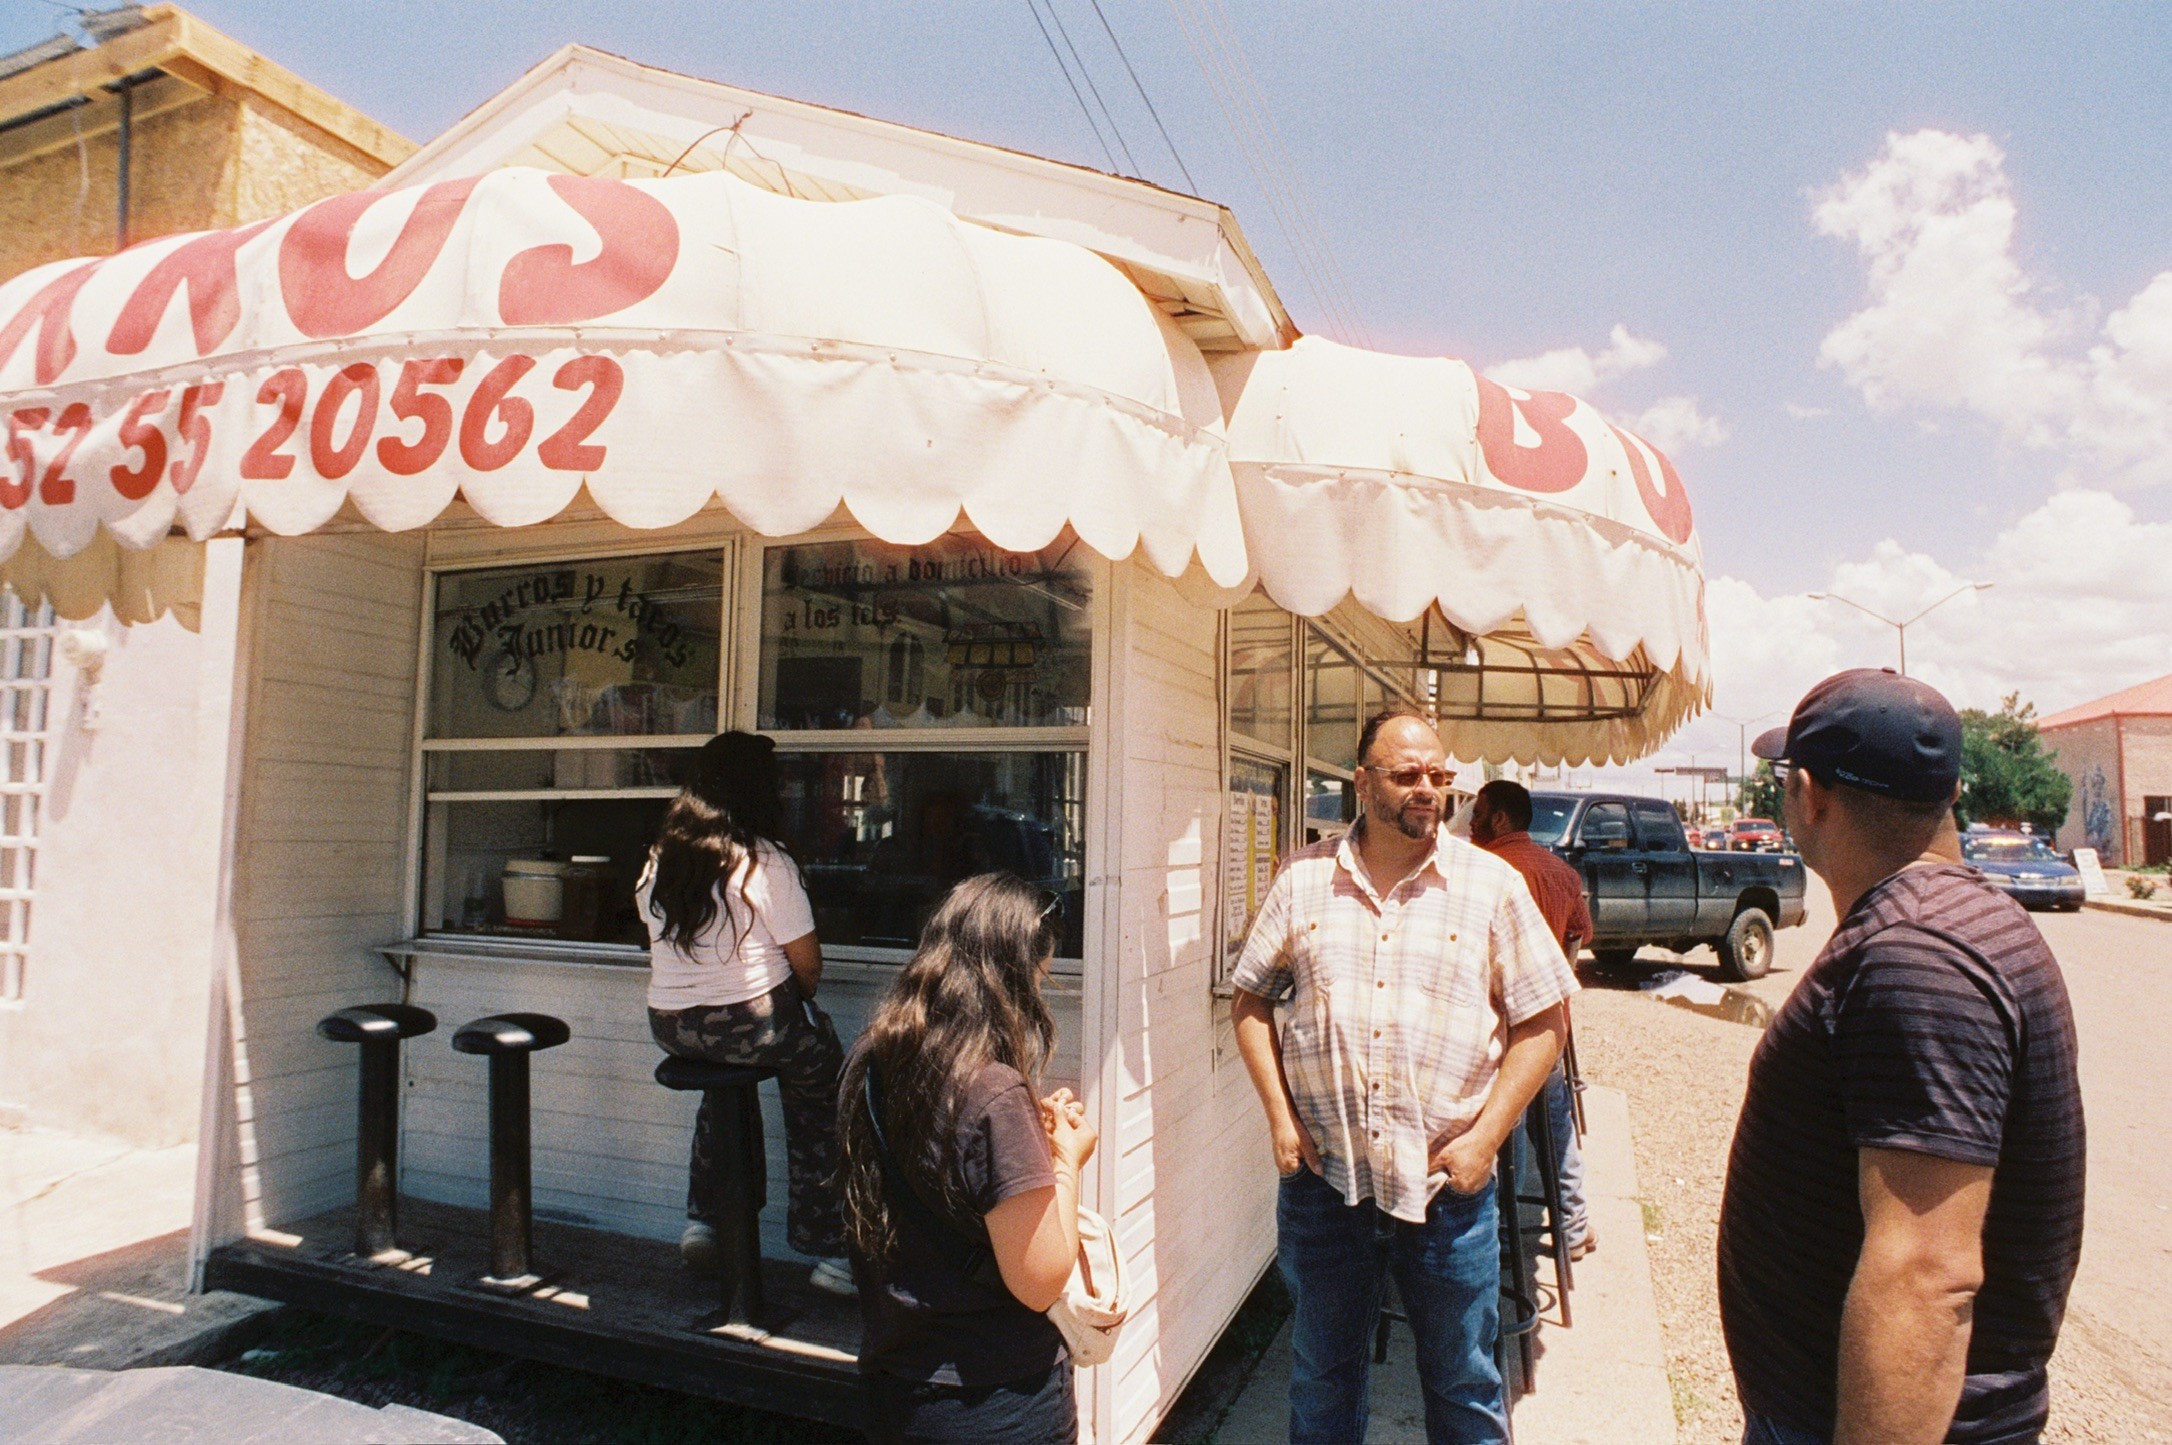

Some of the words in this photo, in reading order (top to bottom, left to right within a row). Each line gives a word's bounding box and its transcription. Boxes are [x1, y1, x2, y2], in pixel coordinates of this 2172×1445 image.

[240, 353, 625, 480] 20562
[451, 572, 574, 671] Burros
[583, 573, 605, 614] y
[784, 611, 796, 630] a
[804, 599, 841, 630] los
